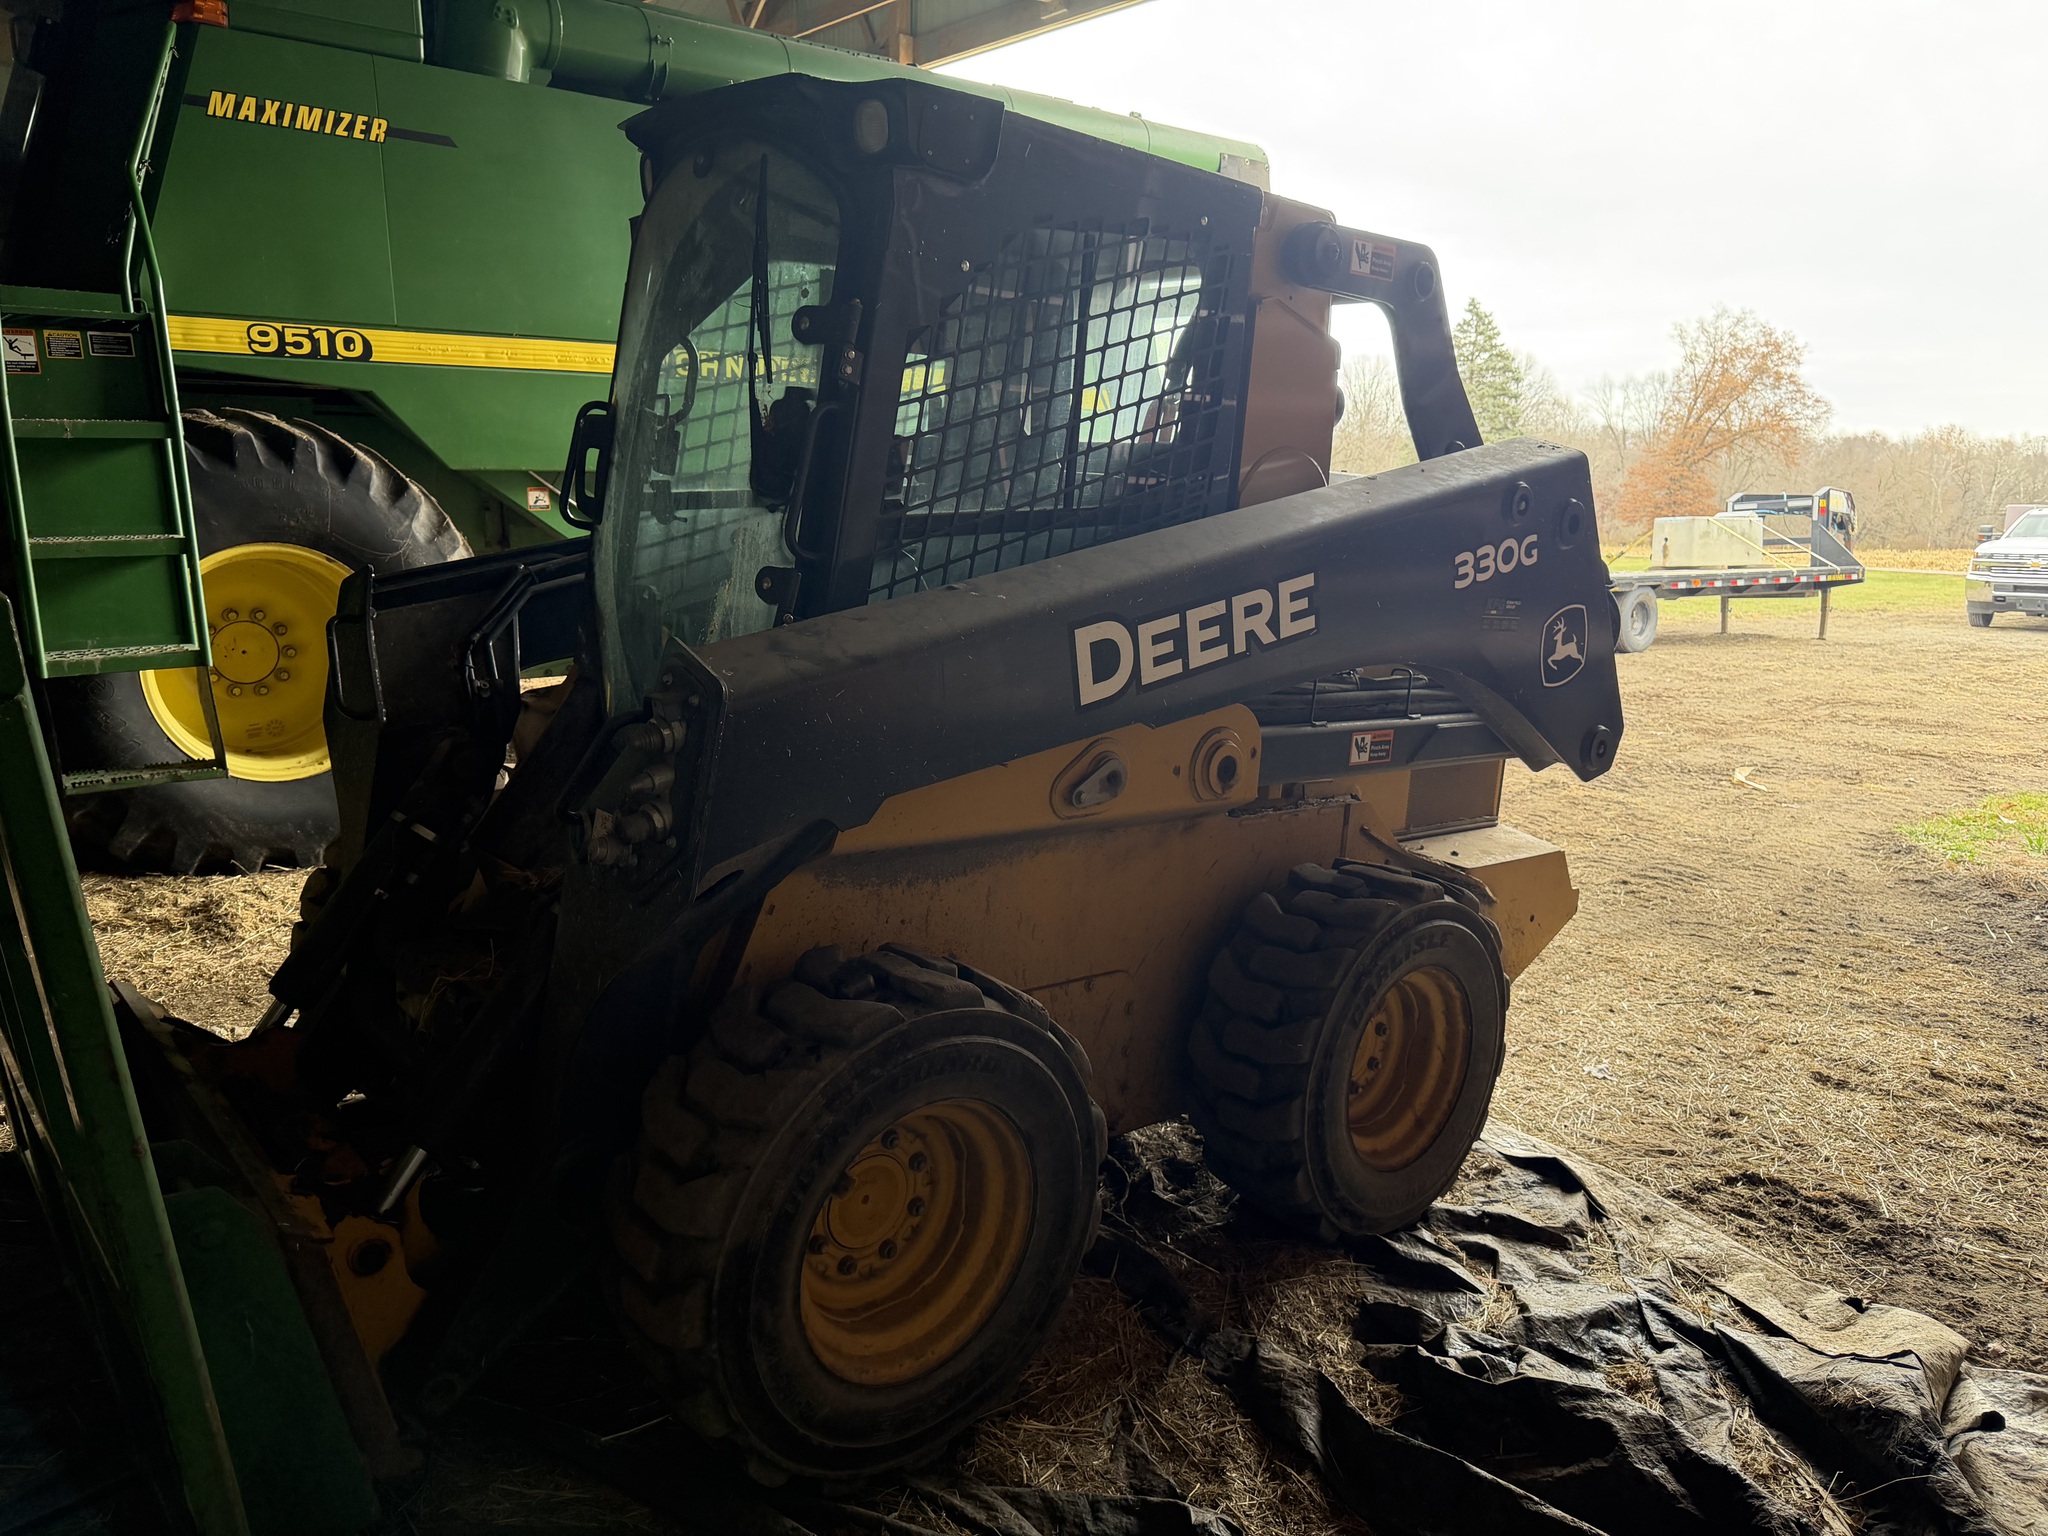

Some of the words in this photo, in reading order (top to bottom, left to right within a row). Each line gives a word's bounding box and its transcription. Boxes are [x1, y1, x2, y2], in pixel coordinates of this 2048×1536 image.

[206, 90, 389, 143] MAXIMIZER
[248, 324, 366, 359] 9510
[1454, 534, 1538, 589] 330G
[1074, 572, 1316, 706] DEERE
